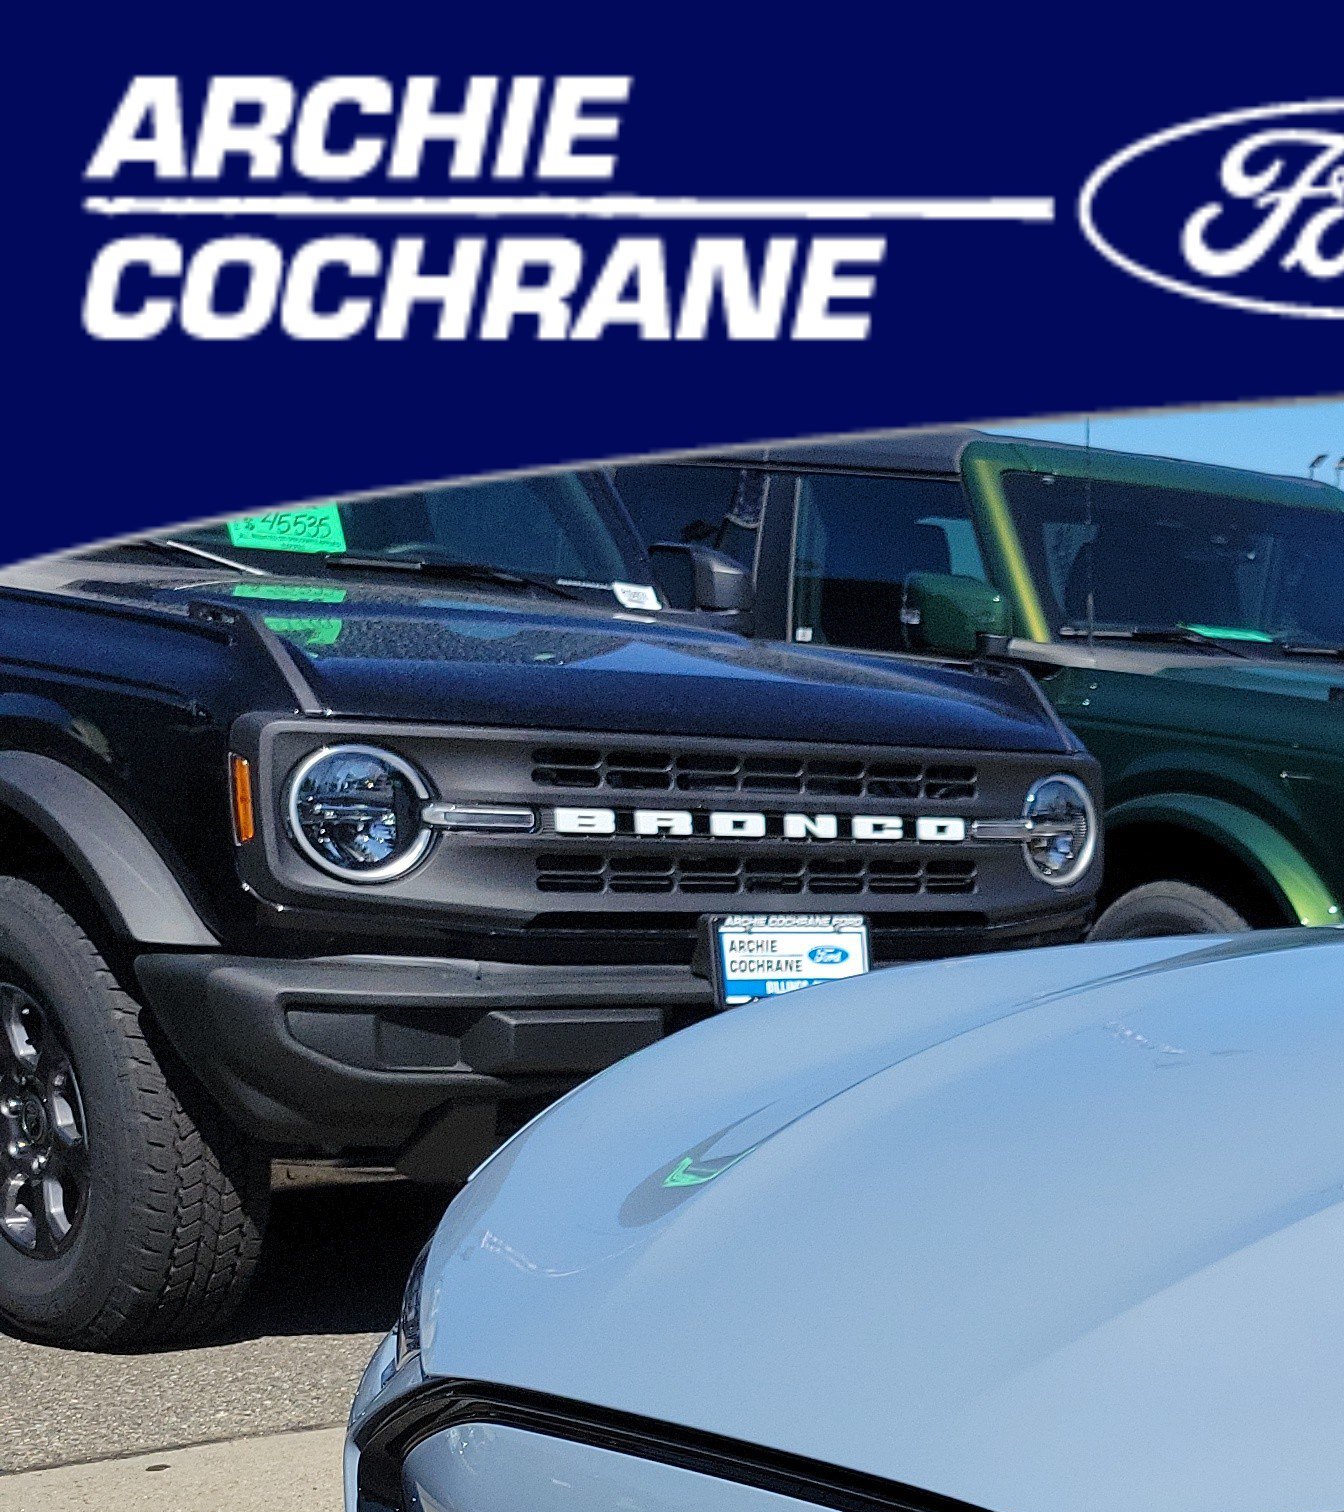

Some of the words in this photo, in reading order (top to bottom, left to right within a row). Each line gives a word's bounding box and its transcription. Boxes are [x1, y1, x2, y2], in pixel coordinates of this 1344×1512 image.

[554, 807, 966, 841] BRONCO
[729, 940, 778, 953] ARCHIE
[814, 947, 843, 963] Ford
[729, 959, 803, 973] COCHRANE
